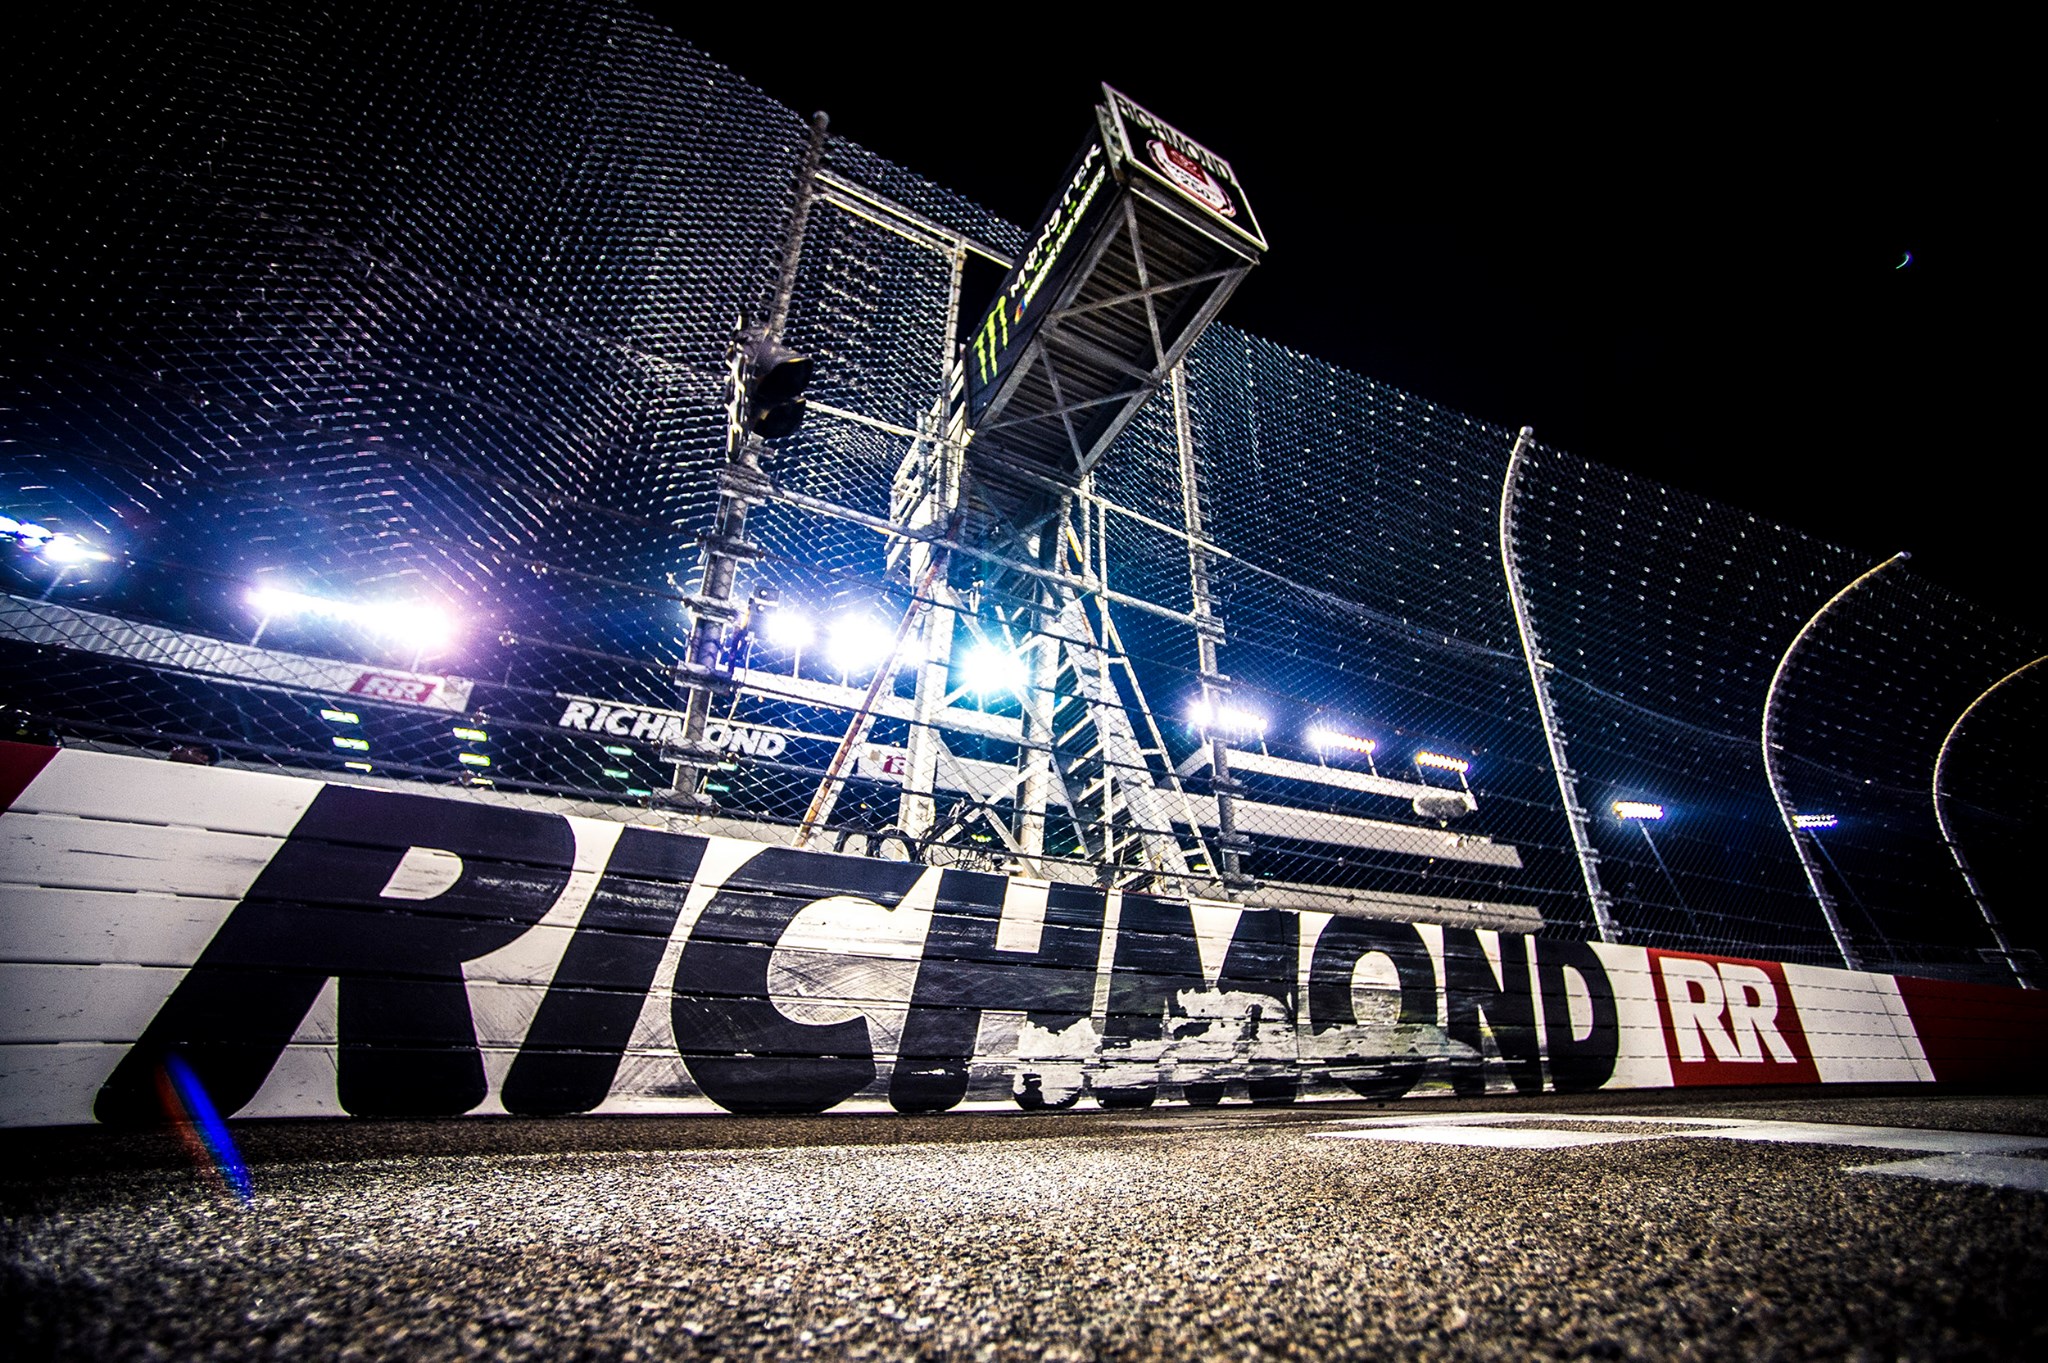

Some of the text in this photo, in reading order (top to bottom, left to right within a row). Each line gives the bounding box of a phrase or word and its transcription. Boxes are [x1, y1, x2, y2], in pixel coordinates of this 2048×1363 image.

[1114, 94, 1233, 182] RICHMOND
[1009, 143, 1102, 298] MONSTER
[360, 675, 425, 702] RR
[93, 783, 1619, 1122] RICHMOND
[1659, 956, 1798, 1064] RR
